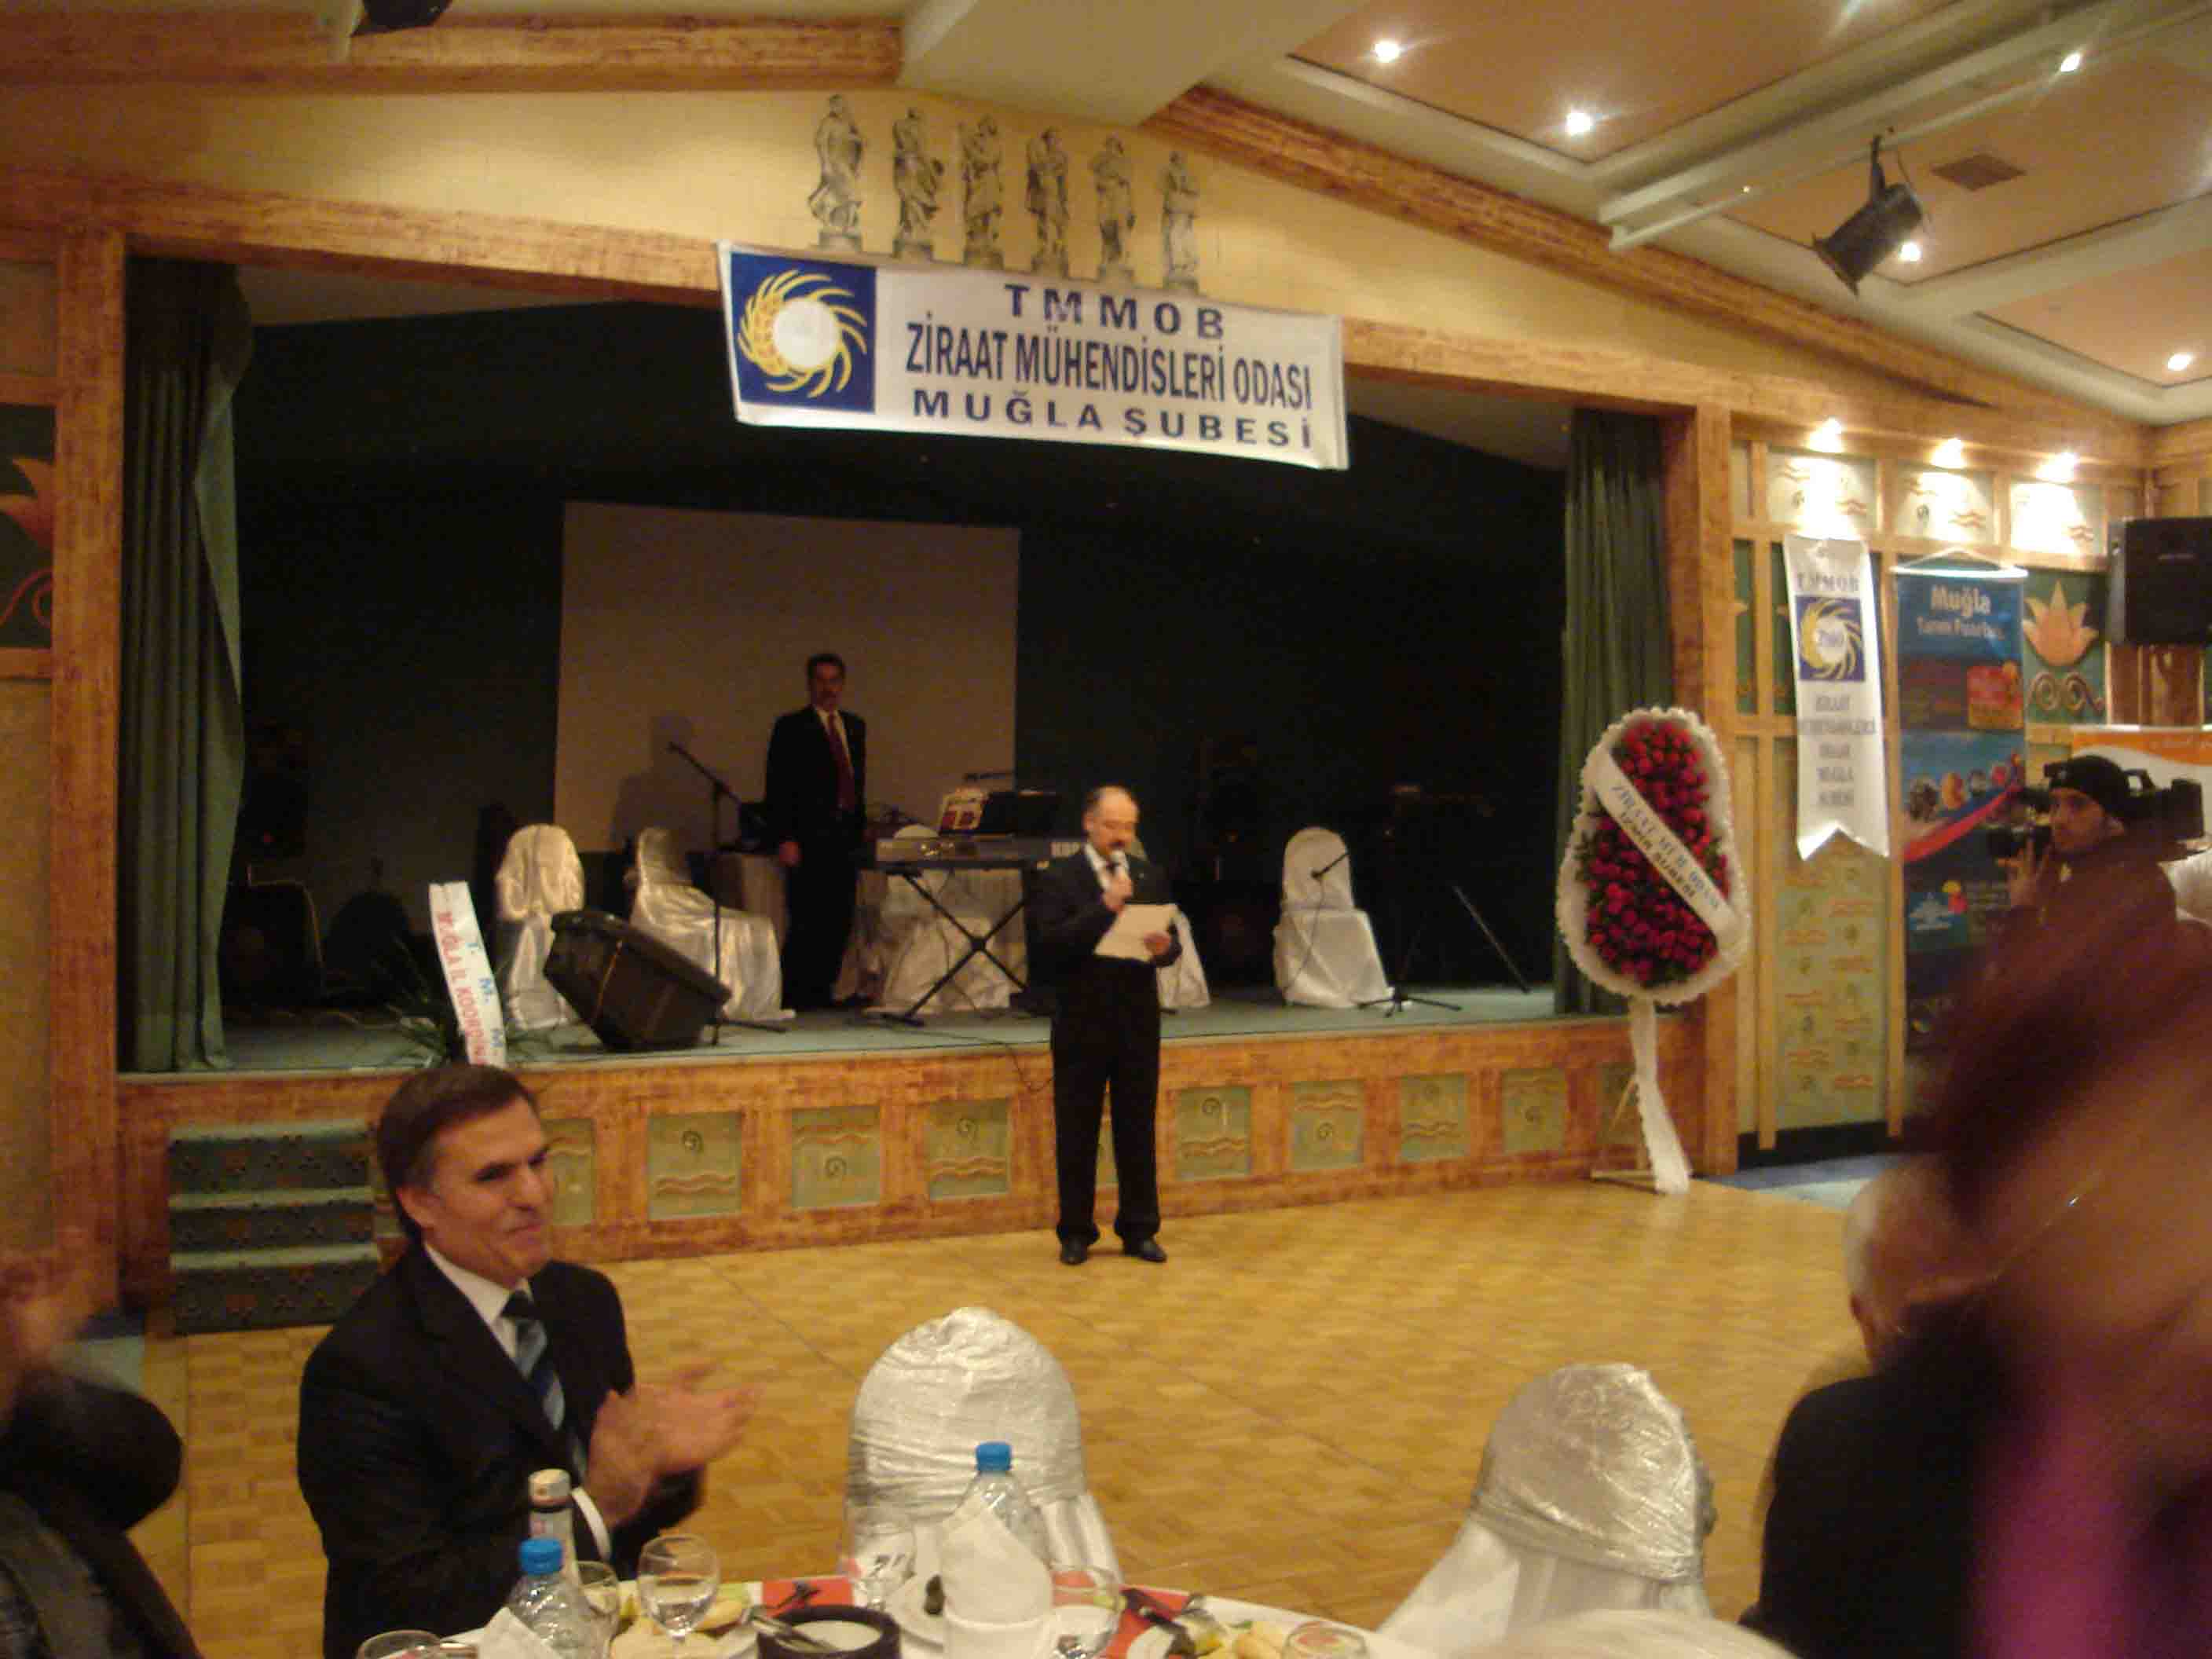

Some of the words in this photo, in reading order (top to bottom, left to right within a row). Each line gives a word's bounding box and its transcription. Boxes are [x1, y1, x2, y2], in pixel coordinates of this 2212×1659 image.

[1004, 284, 1223, 340] TMMOB
[906, 310, 1009, 381] ZİRAAT
[1015, 324, 1225, 402] MÜHENDİSLERİ
[1233, 357, 1312, 410] ODASI
[913, 389, 1103, 430] MUĞLA
